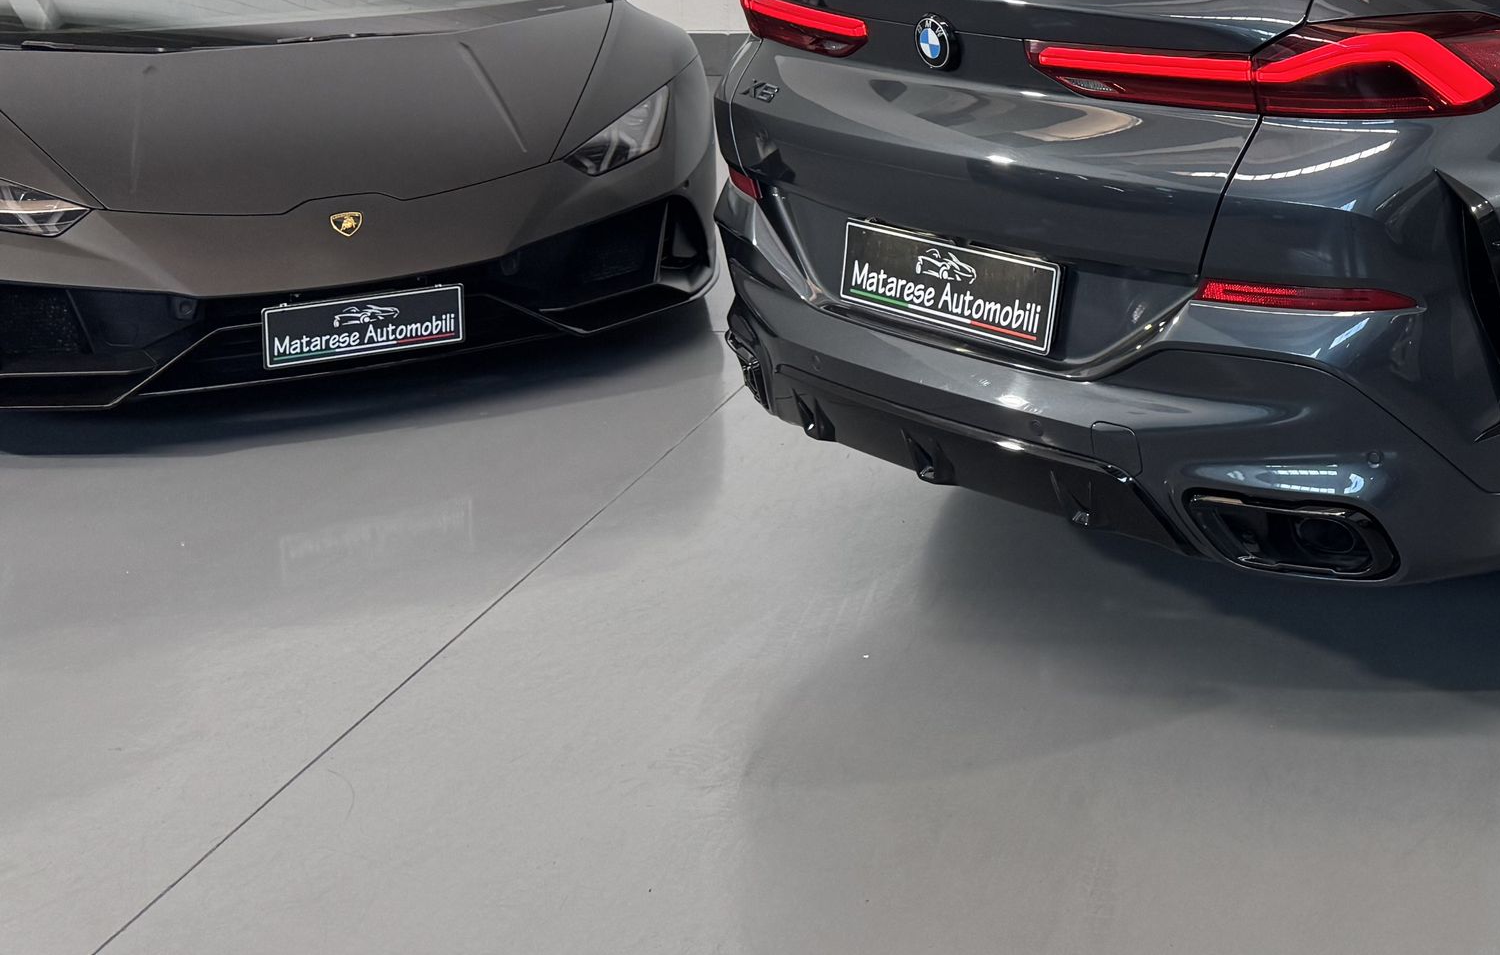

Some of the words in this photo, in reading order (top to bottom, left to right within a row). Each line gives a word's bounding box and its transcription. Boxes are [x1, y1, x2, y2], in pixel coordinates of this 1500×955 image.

[740, 79, 779, 103] X6
[851, 259, 935, 307] Matarese
[937, 282, 1042, 334] Automobili
[273, 330, 360, 356] Matarese
[364, 313, 455, 344] Automobili
